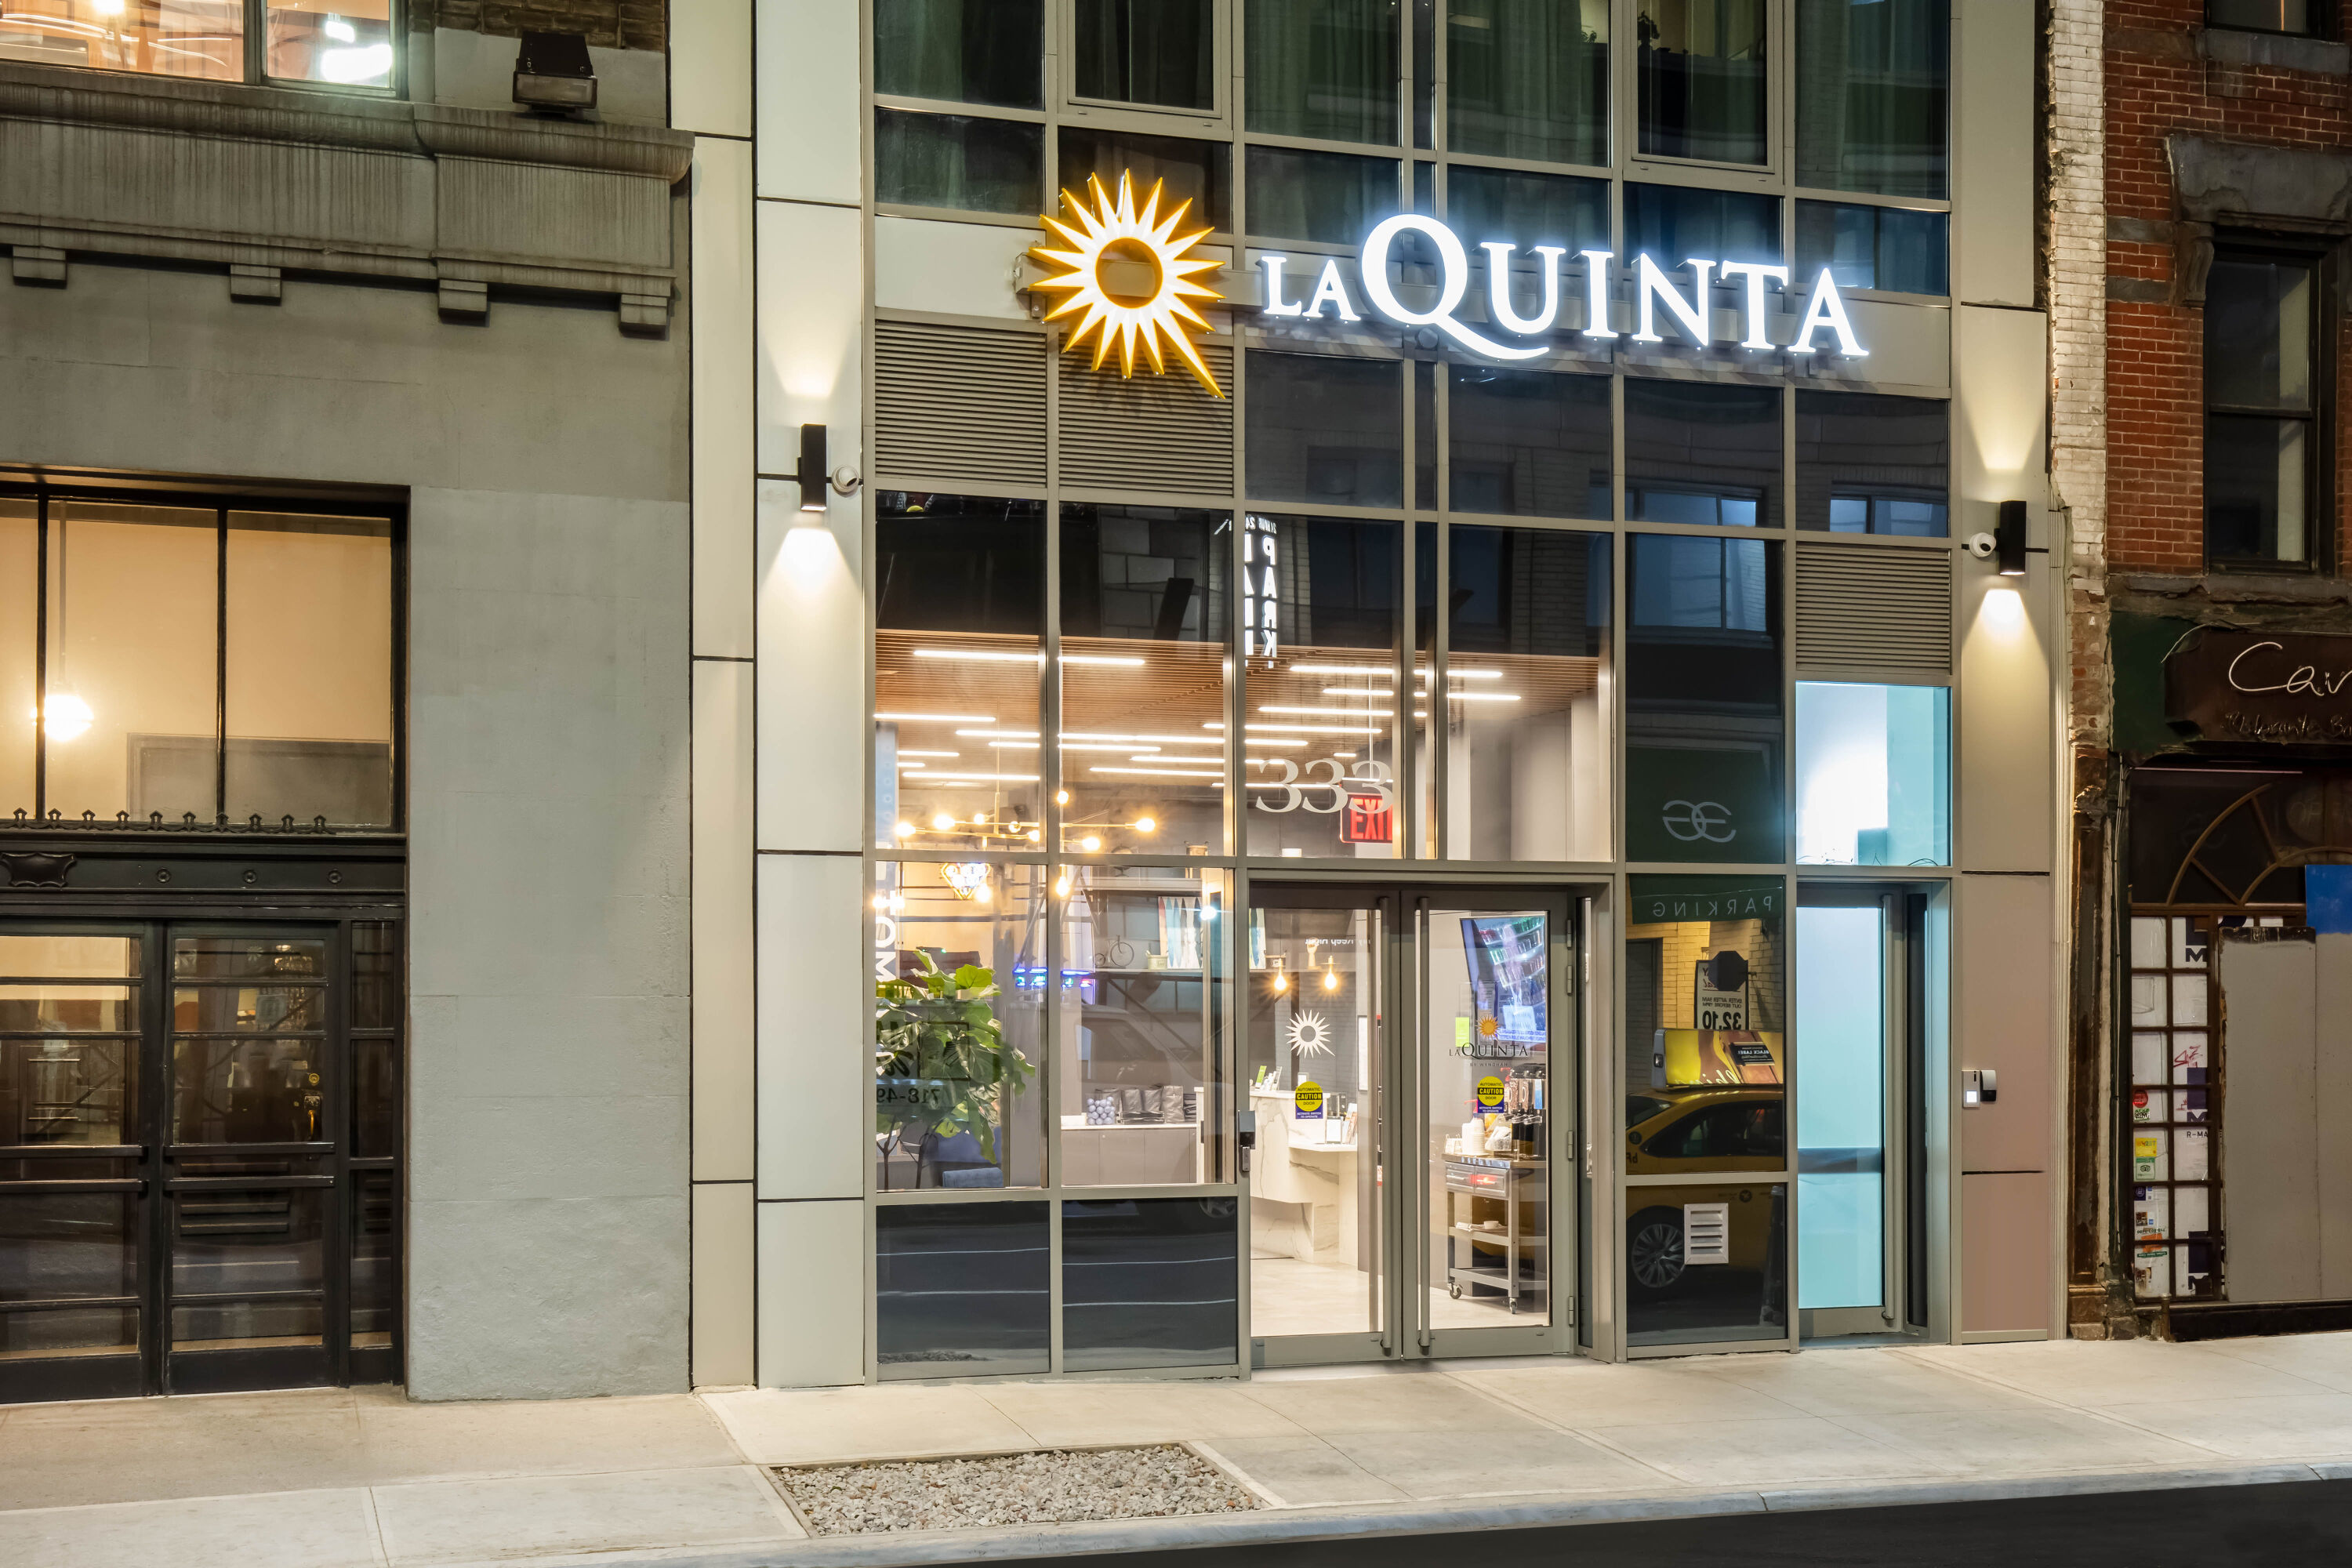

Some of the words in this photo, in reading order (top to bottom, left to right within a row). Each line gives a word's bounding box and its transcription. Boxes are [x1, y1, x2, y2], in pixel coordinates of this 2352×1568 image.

[1257, 256, 1362, 322] LA
[1361, 213, 1869, 361] QUINTA
[1255, 758, 1394, 814] 333
[1461, 1042, 1528, 1060] QUINTA
